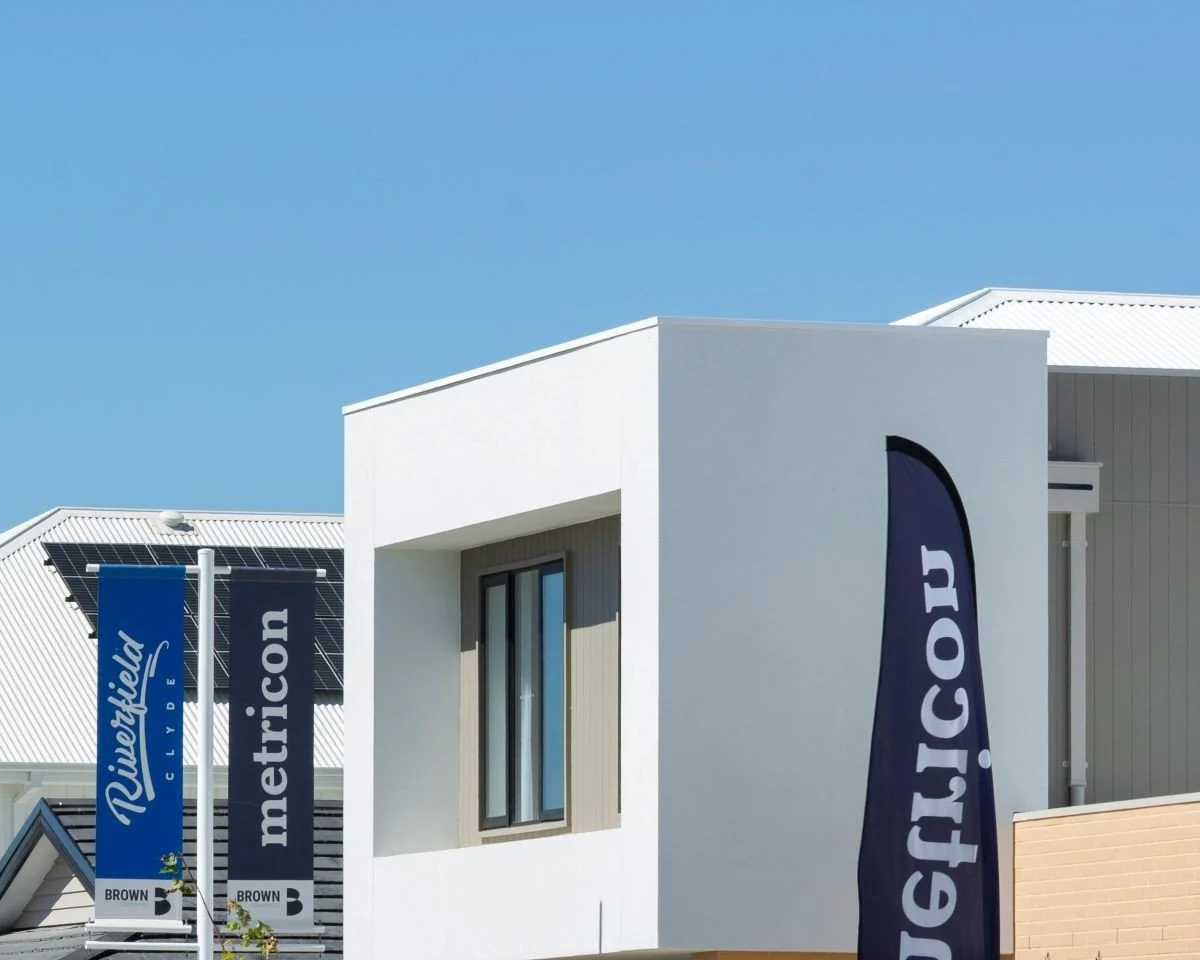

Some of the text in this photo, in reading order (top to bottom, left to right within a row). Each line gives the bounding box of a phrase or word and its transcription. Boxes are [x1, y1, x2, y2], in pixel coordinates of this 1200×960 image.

[104, 630, 157, 826] Riverfield
[165, 677, 176, 781] CLYDE
[245, 608, 289, 848] metricon
[104, 888, 149, 902] BROWN
[237, 890, 280, 903] BROWN
